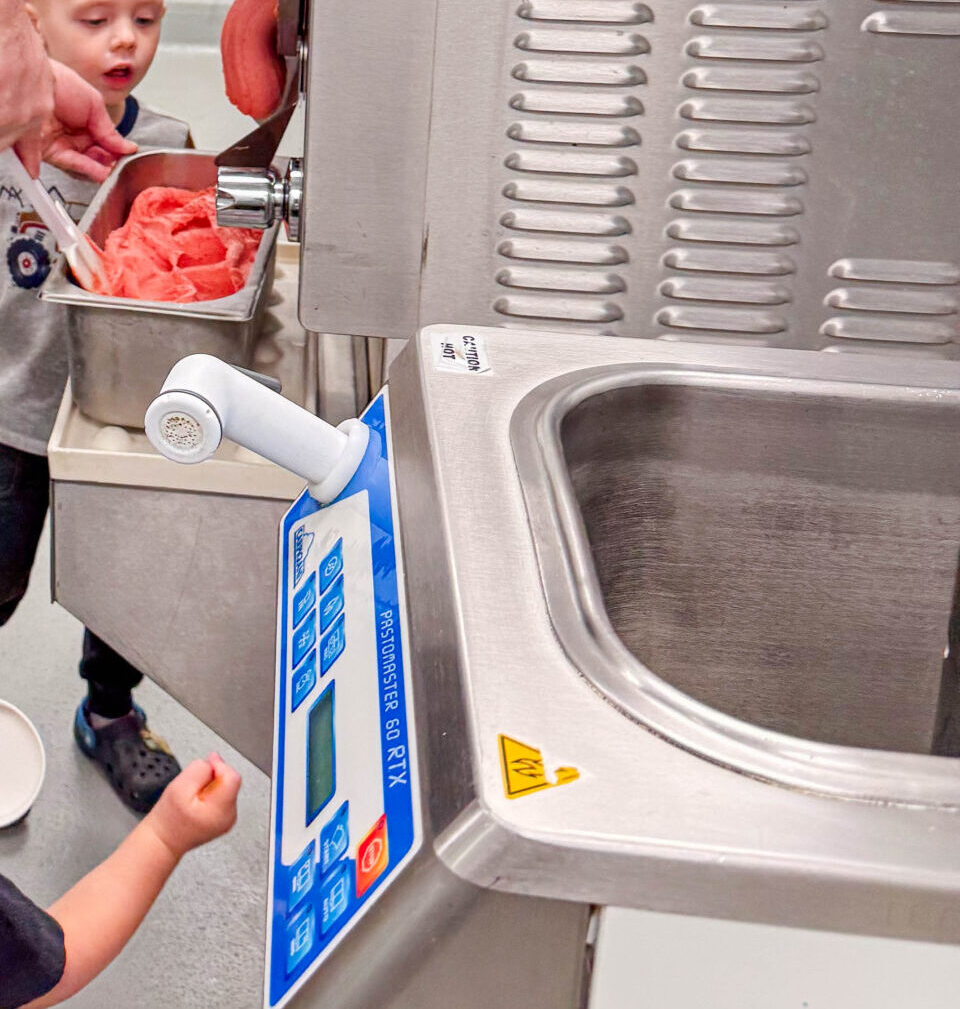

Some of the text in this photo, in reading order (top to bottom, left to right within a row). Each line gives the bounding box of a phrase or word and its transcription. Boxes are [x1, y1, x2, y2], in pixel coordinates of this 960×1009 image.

[440, 342, 456, 360] HOT
[462, 335, 481, 371] CAUTION
[380, 609, 407, 788] PASTOMASTER 60 RTX
